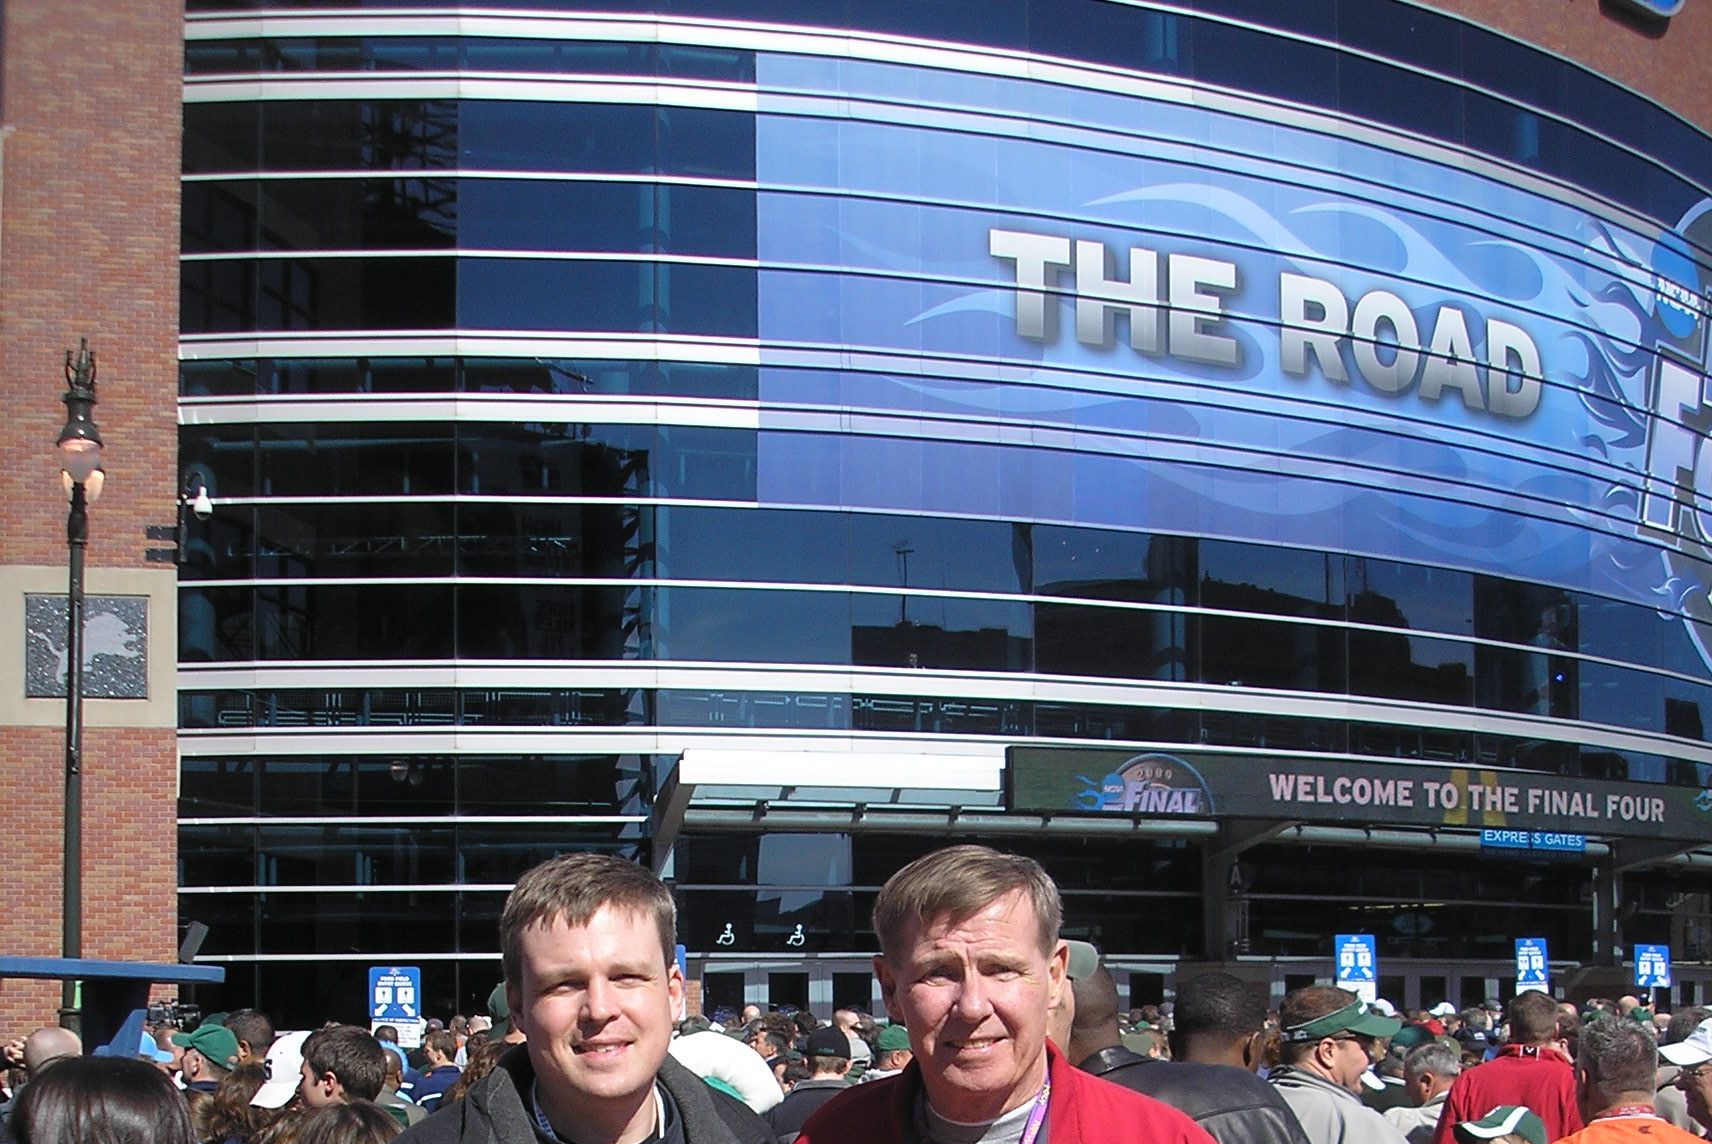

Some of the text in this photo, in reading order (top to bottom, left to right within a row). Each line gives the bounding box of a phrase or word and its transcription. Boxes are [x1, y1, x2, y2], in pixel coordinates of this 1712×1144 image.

[989, 228, 1237, 364] THE
[1280, 271, 1543, 418] ROAD
[1124, 780, 1198, 813] FINAL
[1269, 773, 1665, 822] WELCOME TO THE FINAL FOUR
[1546, 832, 1582, 847] GATES
